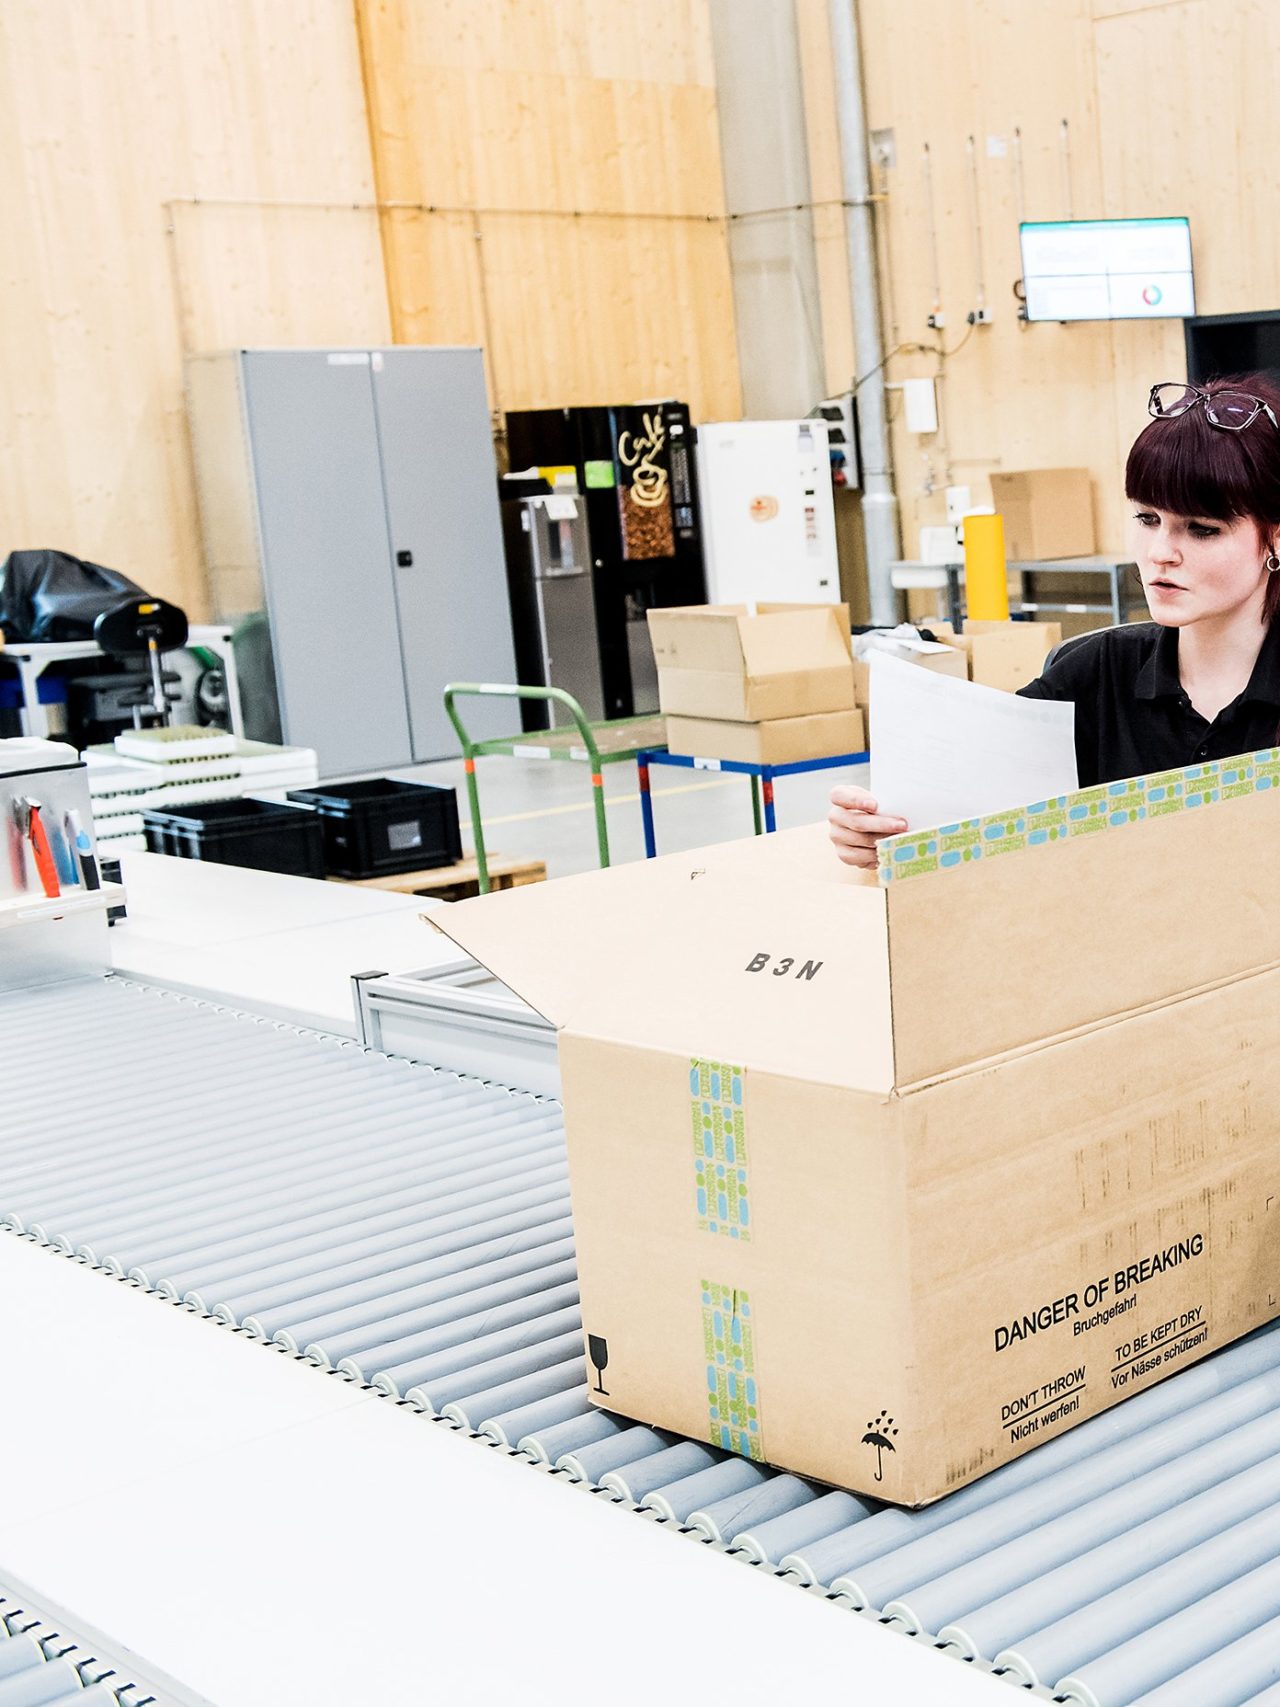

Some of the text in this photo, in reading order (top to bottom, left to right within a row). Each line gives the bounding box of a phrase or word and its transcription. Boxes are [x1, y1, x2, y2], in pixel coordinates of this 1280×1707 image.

[994, 1233, 1203, 1353] DANGER OF BREAKING
[1073, 1293, 1137, 1337] Bruchgefahr!
[1111, 1326, 1208, 1389] Vor Nässe schützen!
[1115, 1304, 1203, 1362] TO BE KEPT DRY
[1001, 1365, 1086, 1422] DON'T THROW
[1010, 1395, 1080, 1444] Nicht werfen!
